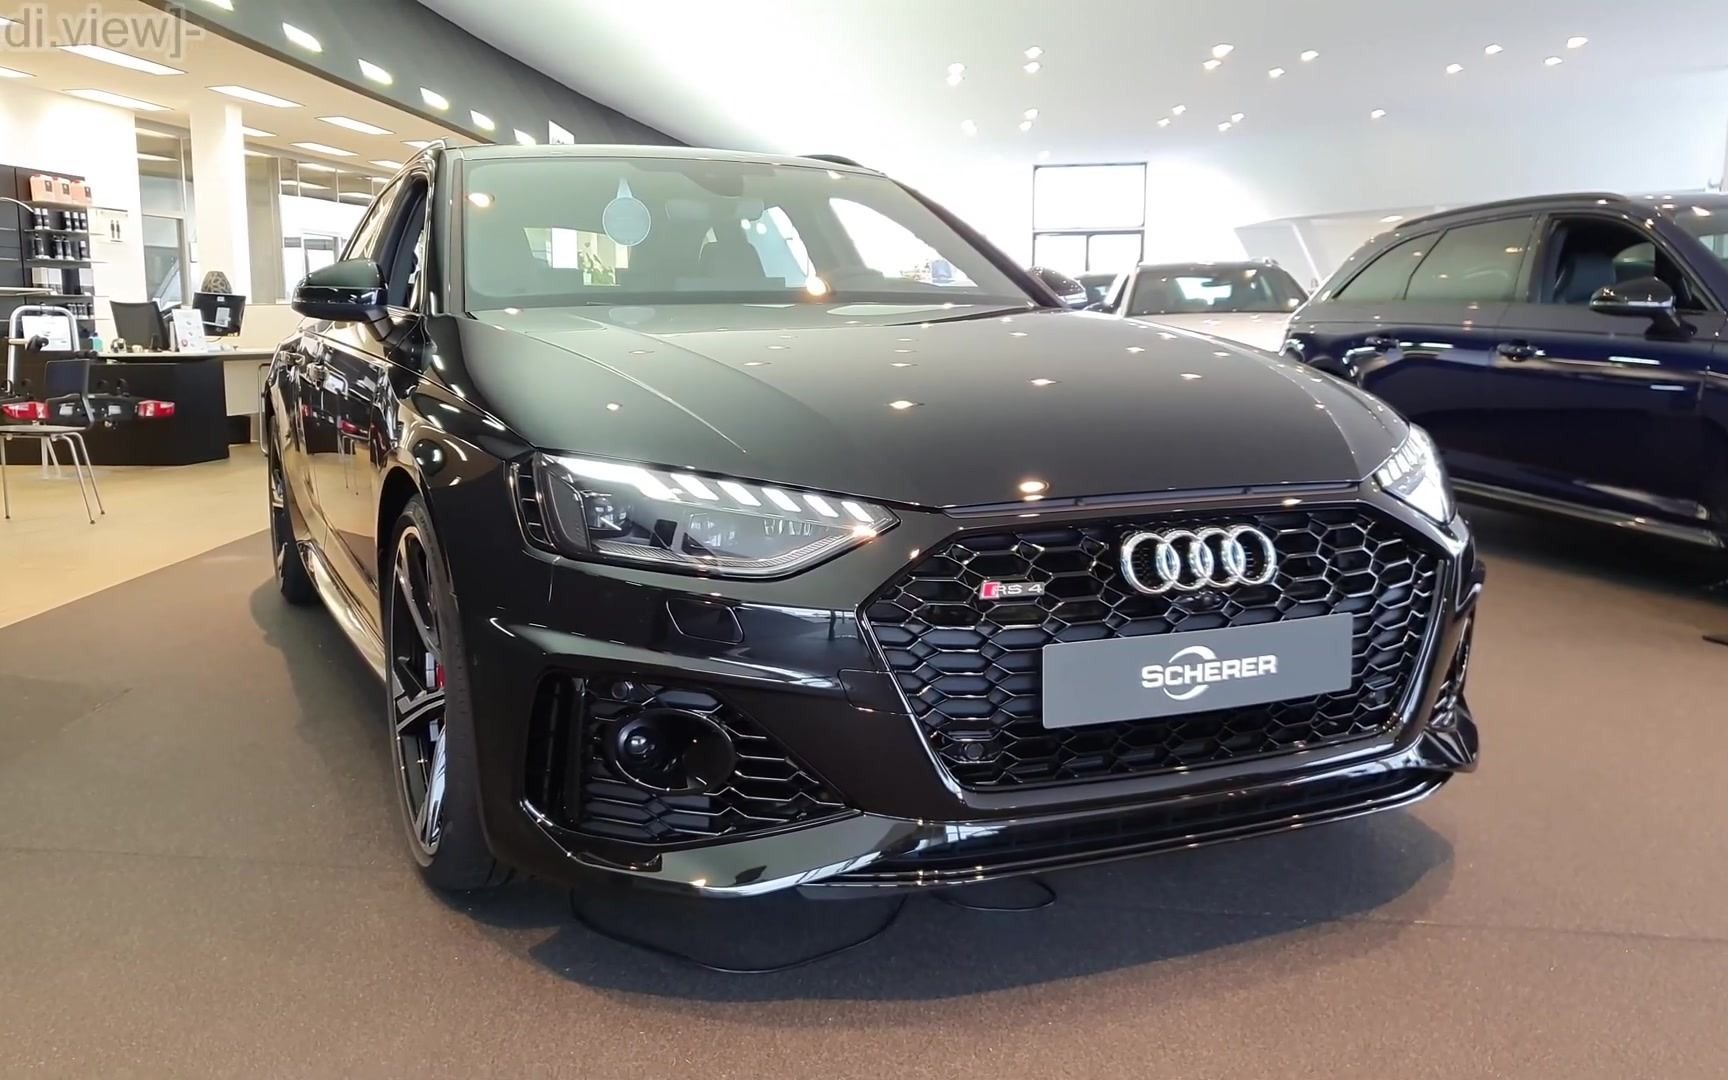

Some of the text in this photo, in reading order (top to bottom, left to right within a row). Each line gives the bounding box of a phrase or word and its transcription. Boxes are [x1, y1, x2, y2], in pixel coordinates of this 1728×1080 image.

[987, 583, 1042, 597] RS 4
[1141, 655, 1278, 688] SCHERER
